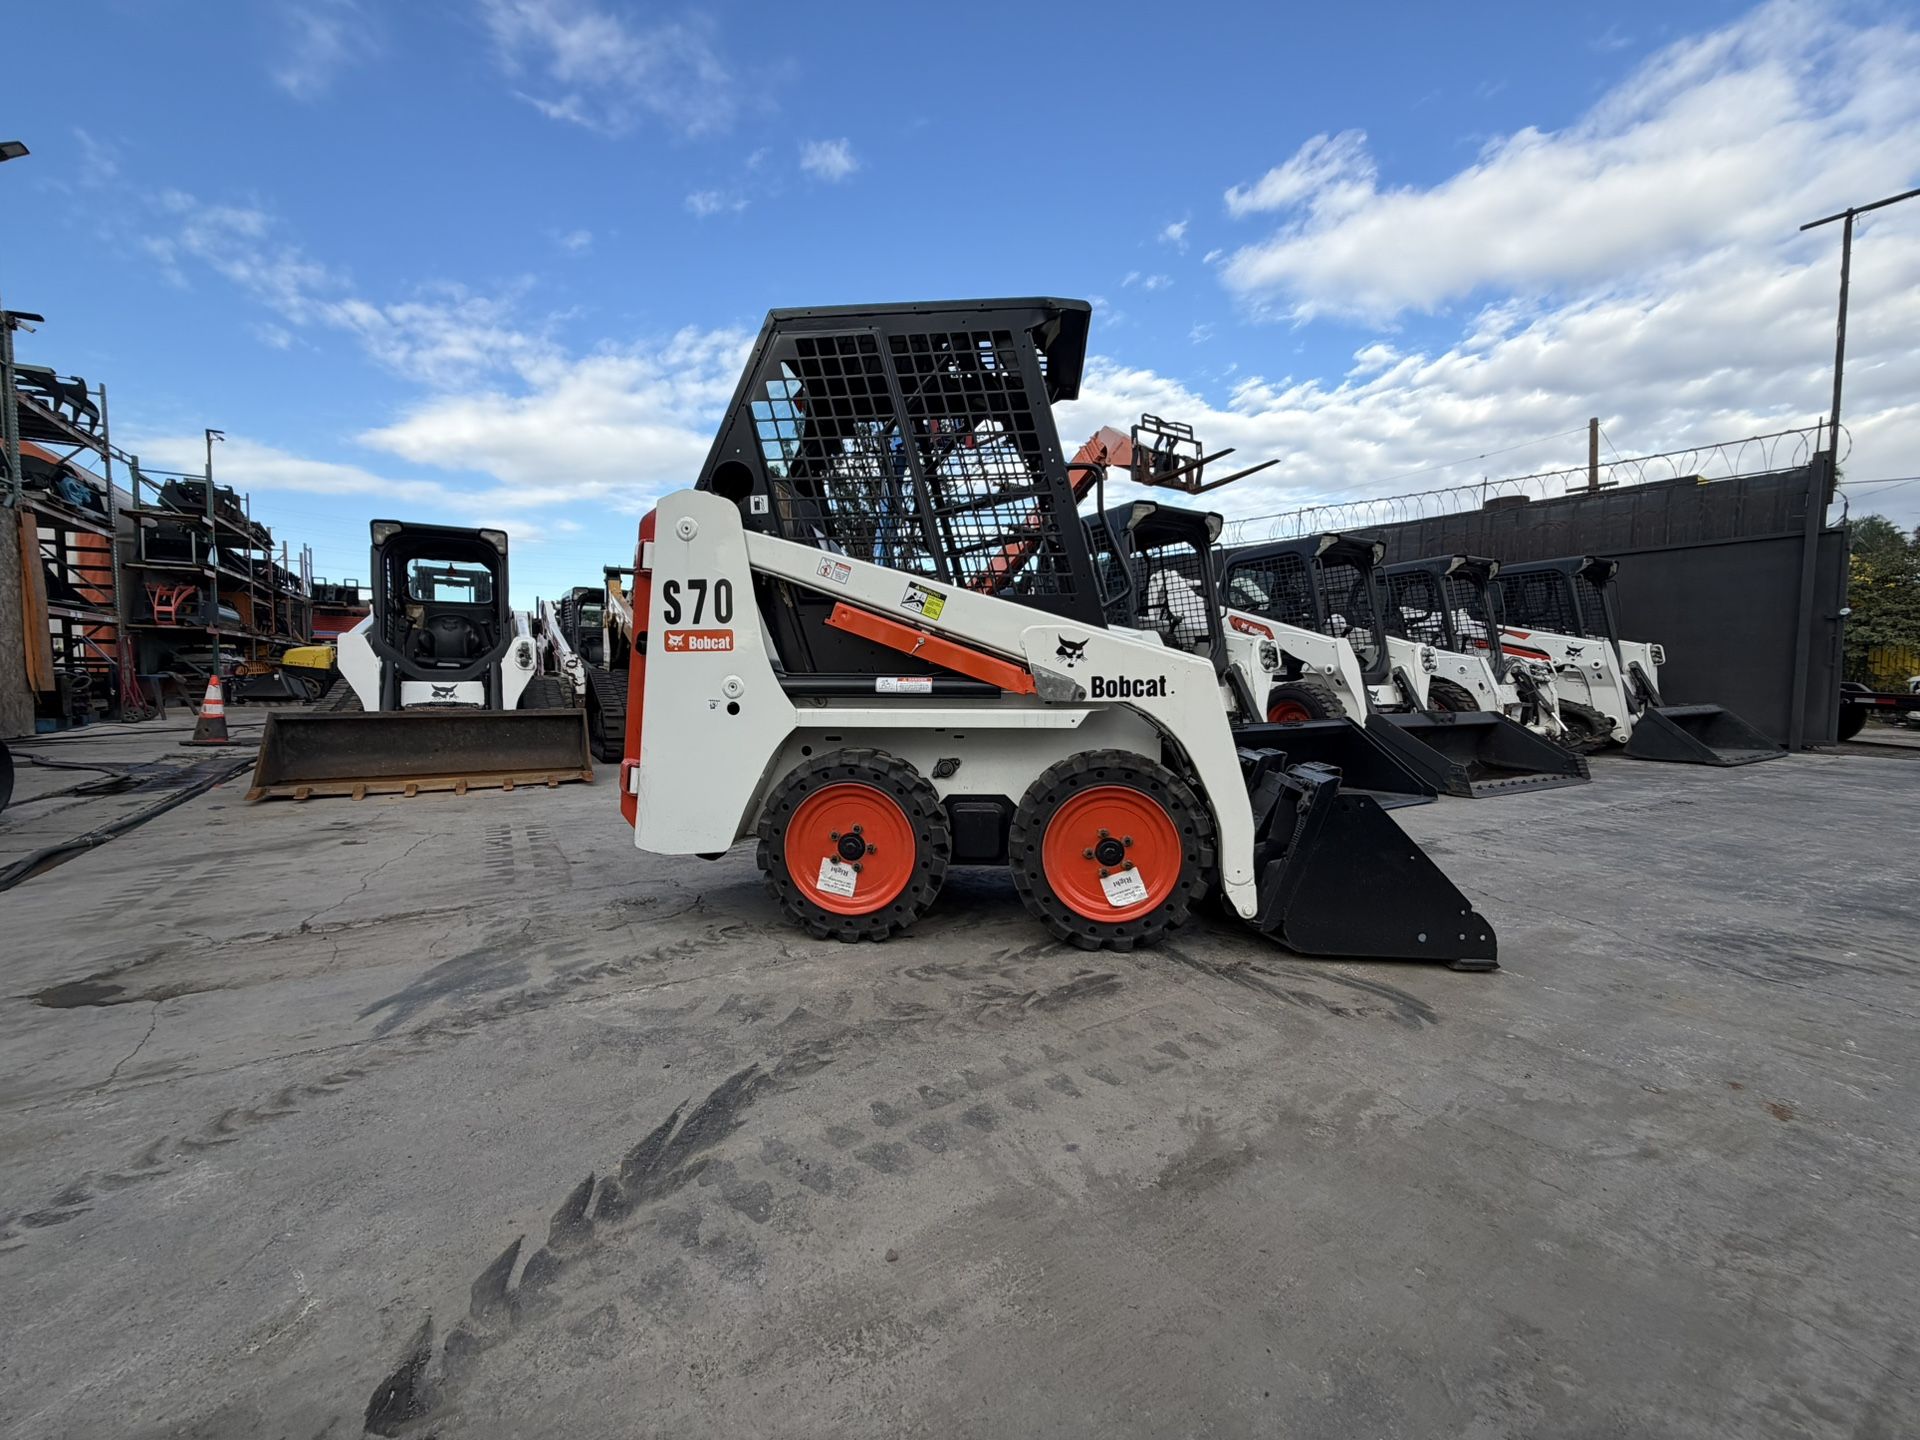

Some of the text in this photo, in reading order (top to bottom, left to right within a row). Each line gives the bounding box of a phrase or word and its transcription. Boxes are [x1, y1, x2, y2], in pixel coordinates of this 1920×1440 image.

[663, 578, 733, 625] S70
[688, 635, 731, 650] Bobcat
[1091, 675, 1167, 698] Bobcat
[830, 866, 849, 877] Right
[1112, 876, 1132, 887] Right
